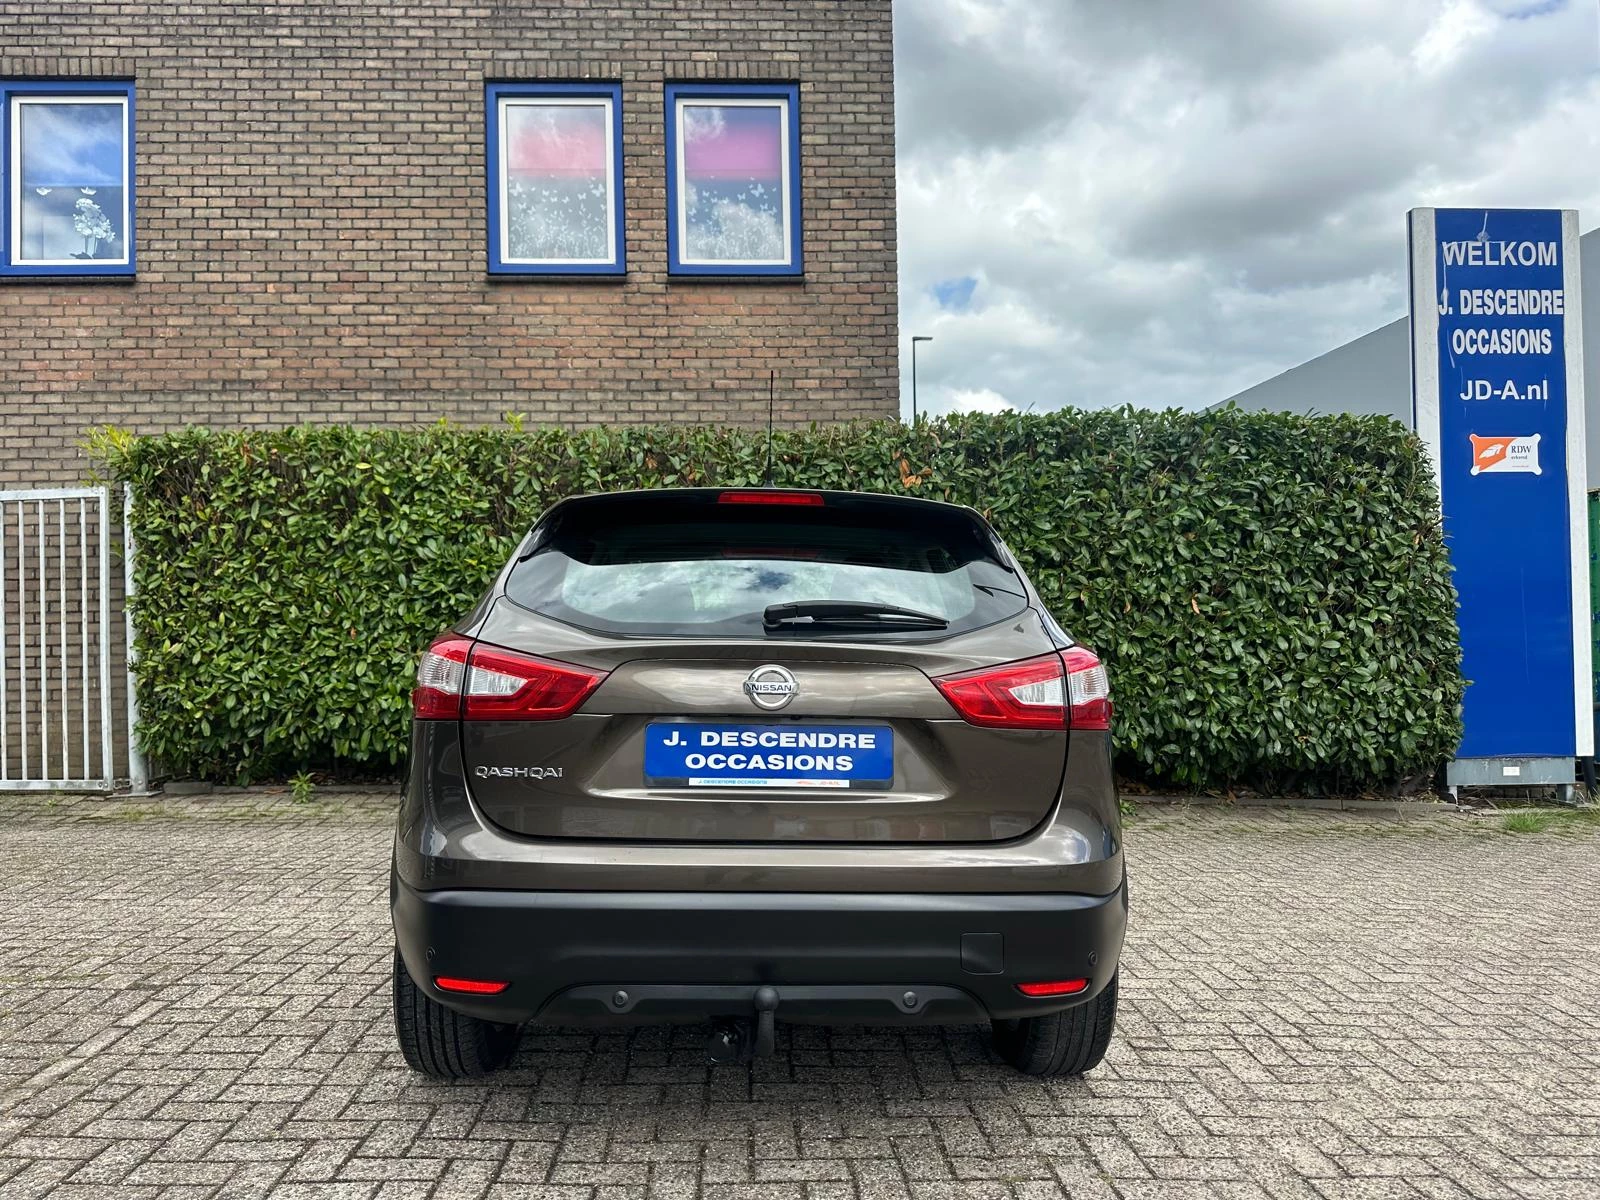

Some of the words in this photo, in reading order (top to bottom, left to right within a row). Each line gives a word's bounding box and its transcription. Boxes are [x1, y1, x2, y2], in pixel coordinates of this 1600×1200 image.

[1441, 241, 1557, 266] WELKOM
[1438, 288, 1453, 316] J.
[1460, 288, 1564, 316] DESCENDRE
[1452, 328, 1552, 355] OCCASIONS
[1459, 379, 1548, 401] JD-A.nl
[1511, 445, 1532, 454] RDW
[751, 684, 792, 692] NISSAN
[663, 731, 687, 747] J.
[699, 731, 876, 749] DESCENDRE
[685, 753, 854, 772] OCCASIONS
[475, 765, 563, 780] QASHQAI
